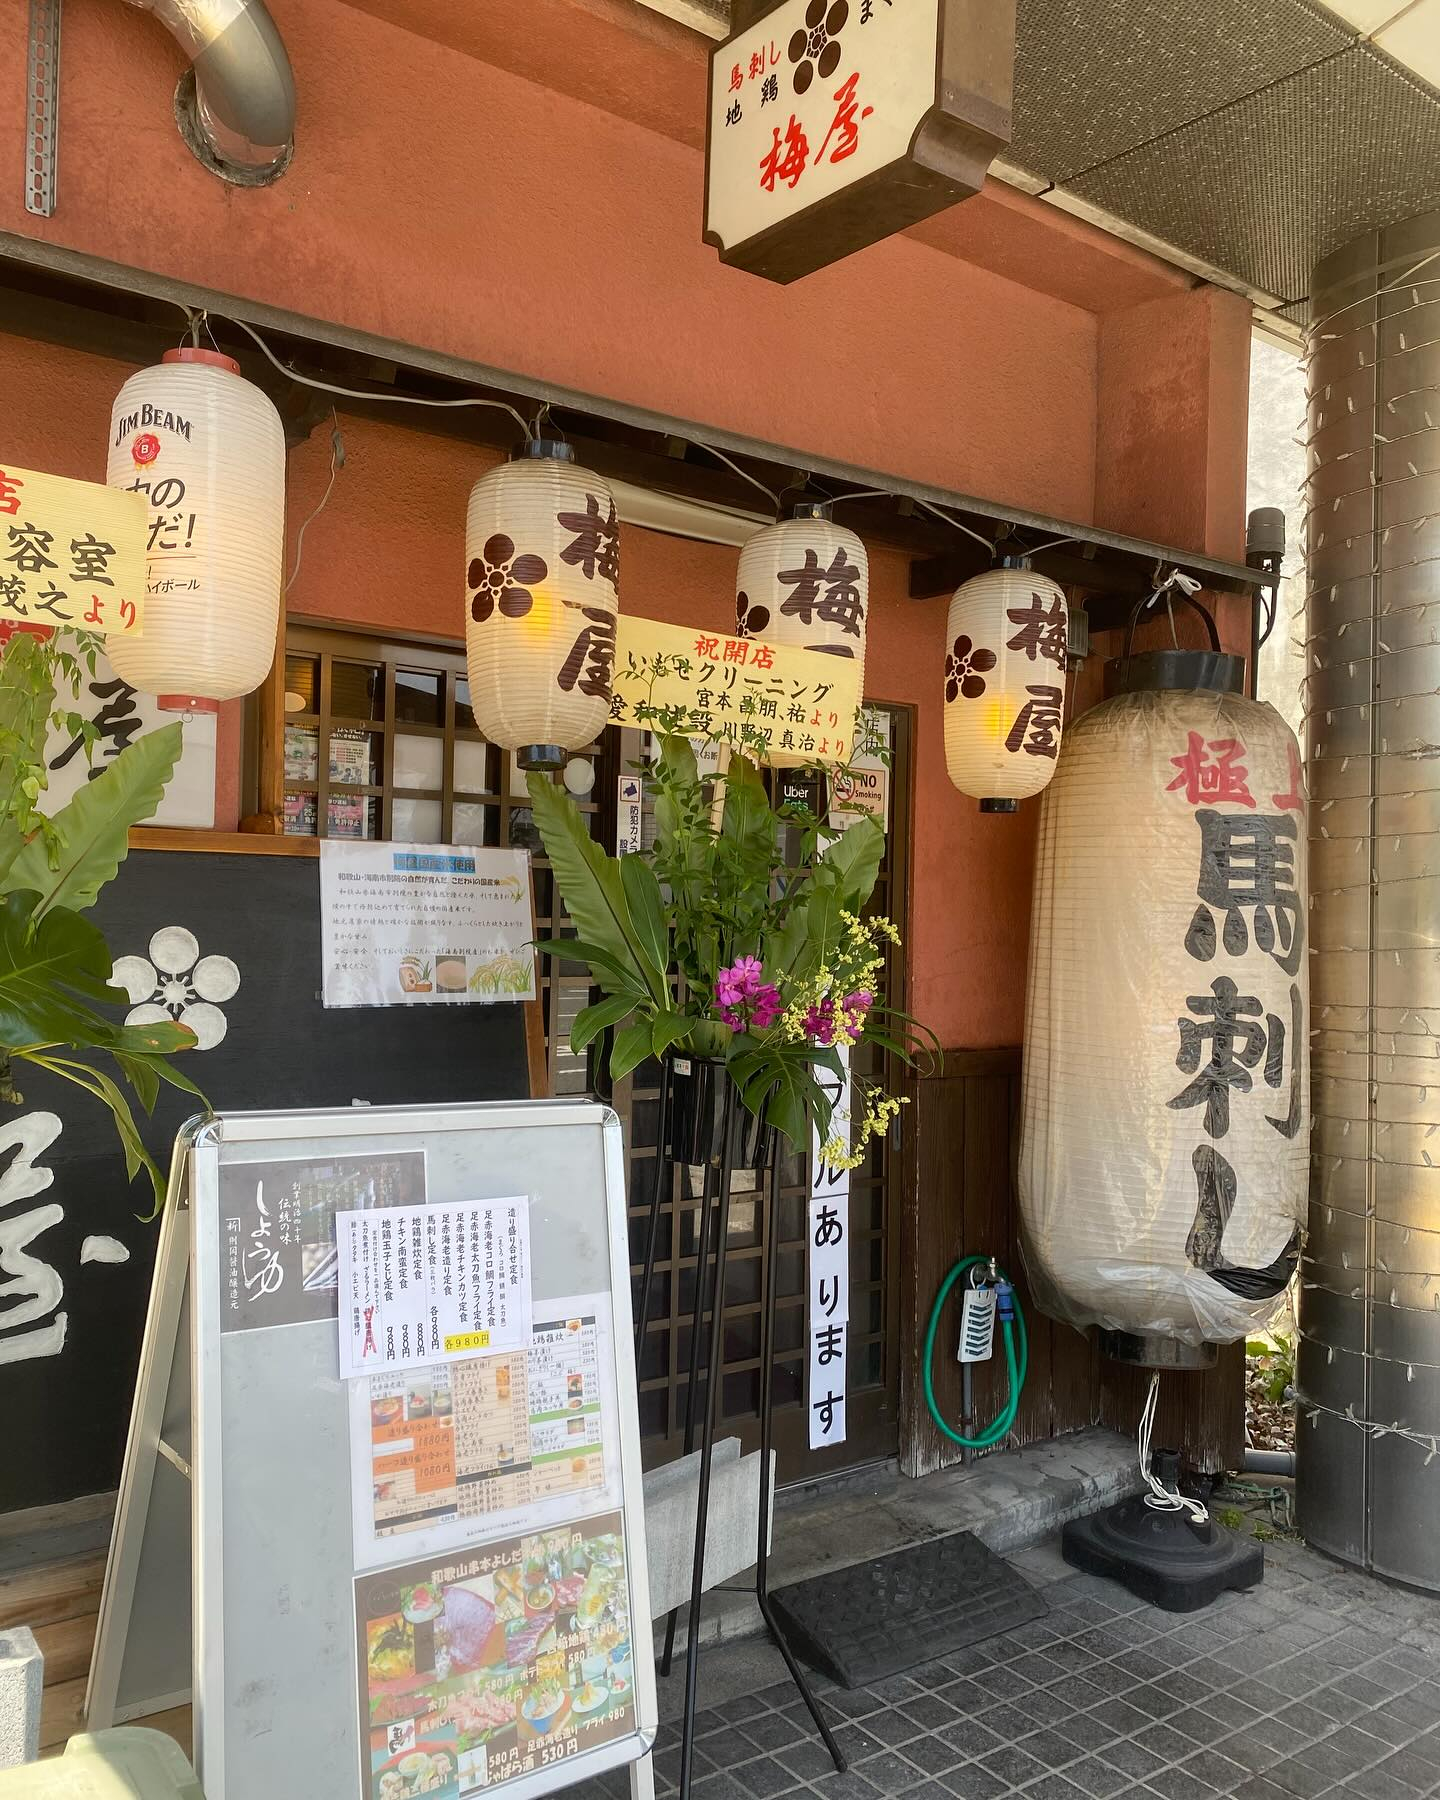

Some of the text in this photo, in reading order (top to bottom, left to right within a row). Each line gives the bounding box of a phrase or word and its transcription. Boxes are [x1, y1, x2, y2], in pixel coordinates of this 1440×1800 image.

[729, 41, 781, 92] 馬刺し
[759, 72, 874, 192] 梅屋
[115, 403, 192, 447] JIM BEAM
[776, 546, 865, 660] 梅
[694, 633, 777, 671] 祝開店
[784, 785, 809, 799] Uber
[855, 789, 882, 801] Smoking
[860, 775, 877, 788] NO
[1166, 811, 1306, 1302] 馬刺し
[241, 1180, 284, 1302] しょうゆ
[278, 1198, 293, 1246] 伝統の味
[608, 1707, 625, 1722] 980
[541, 1738, 579, 1765] 530円
